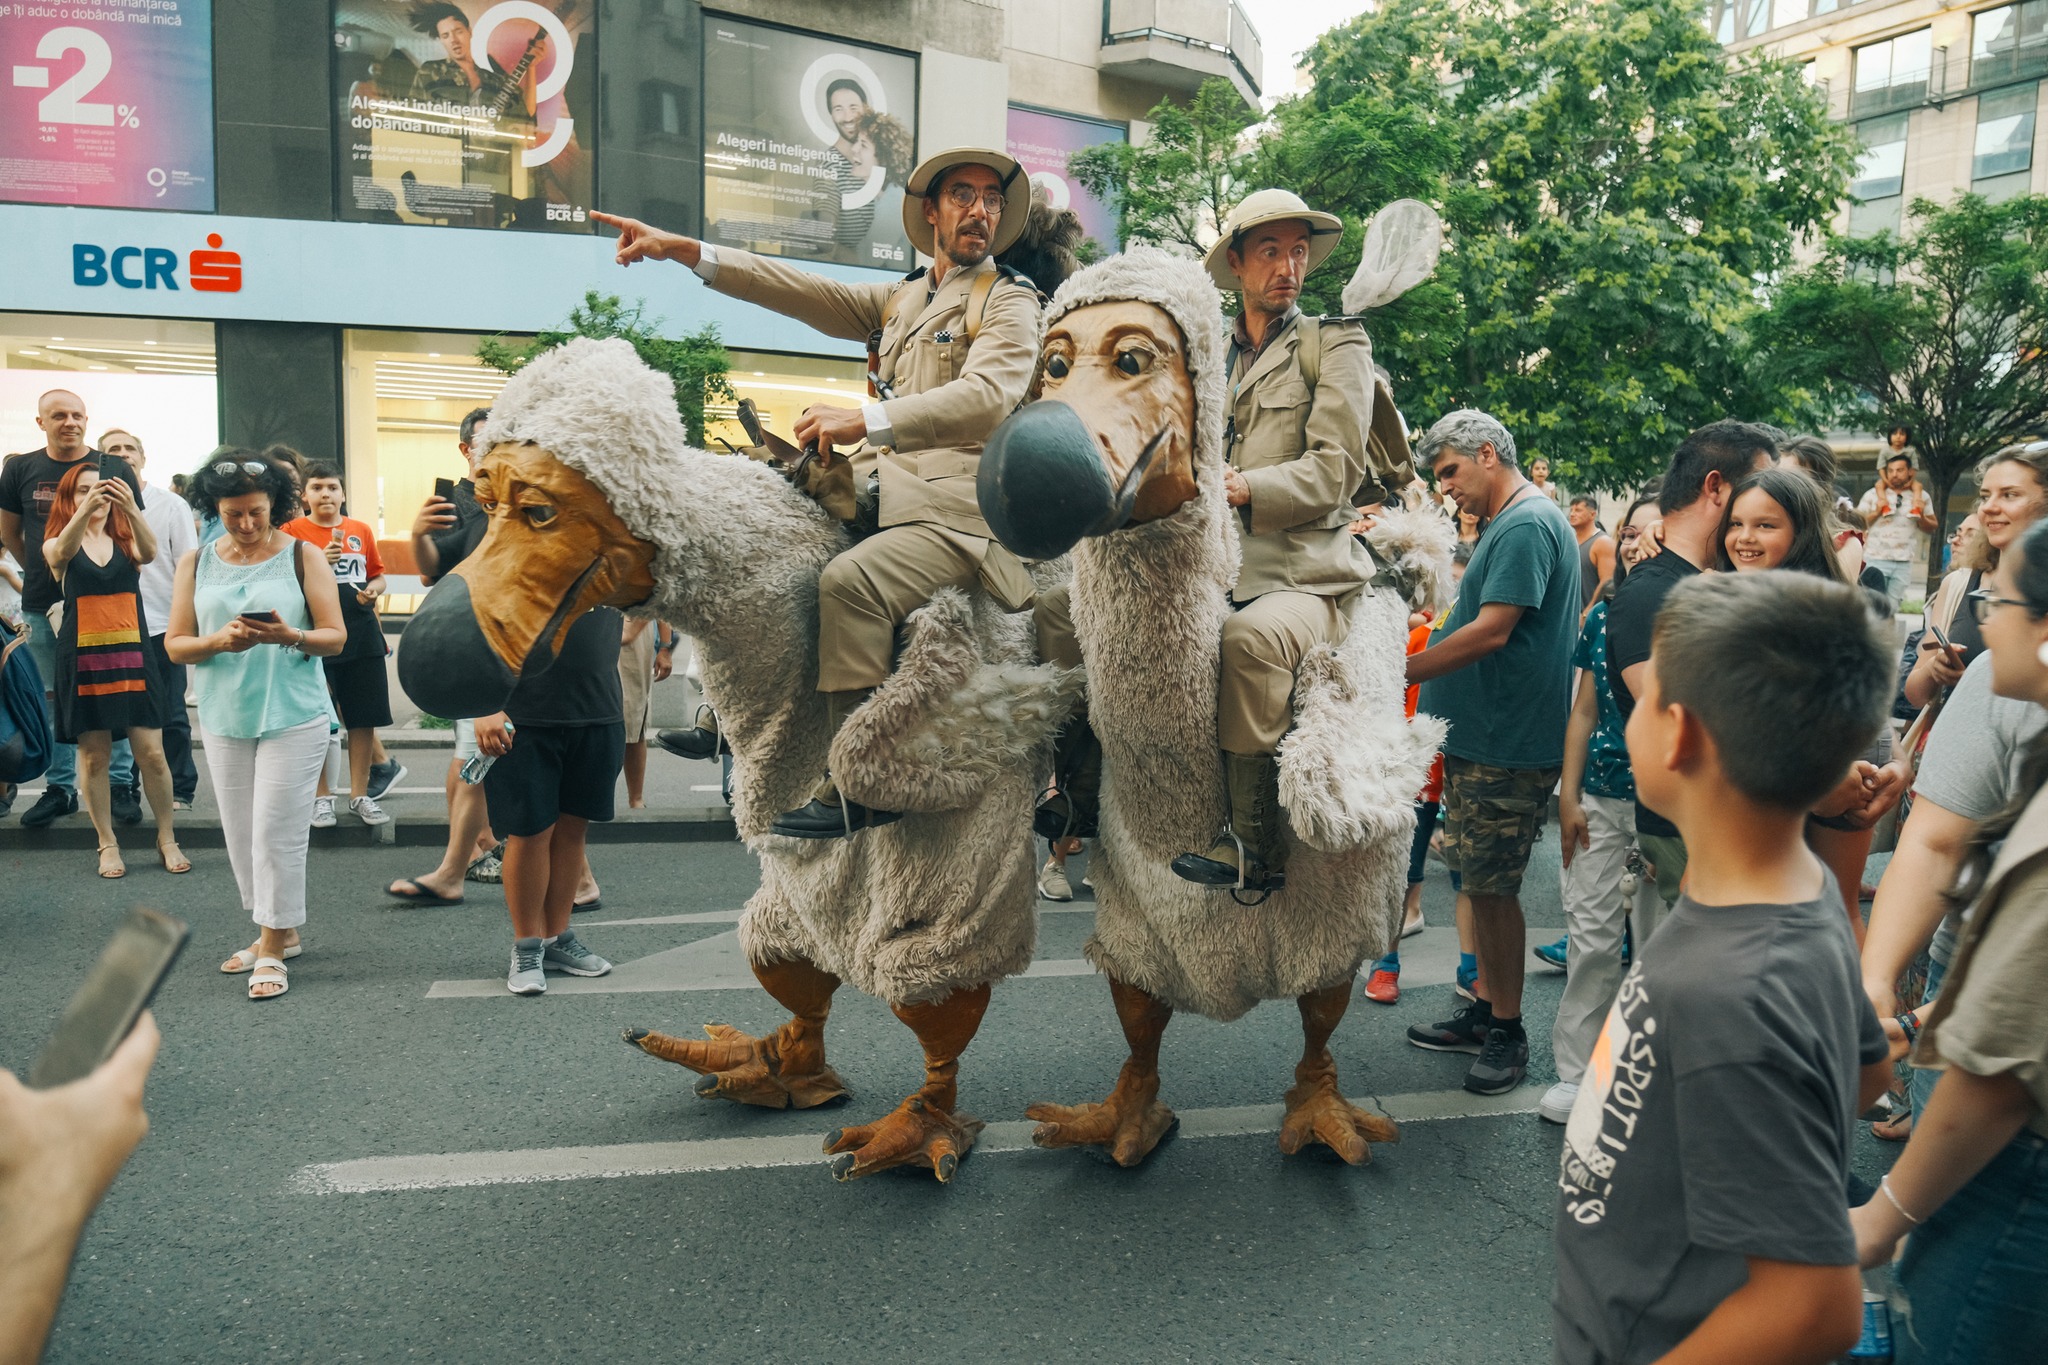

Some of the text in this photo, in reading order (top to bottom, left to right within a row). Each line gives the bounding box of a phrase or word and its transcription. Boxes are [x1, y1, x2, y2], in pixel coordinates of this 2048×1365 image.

[28, 6, 57, 18] aduc
[61, 9, 68, 18] o
[72, 8, 124, 22] dobândă
[128, 12, 150, 24] mai
[153, 14, 182, 26] mică
[352, 95, 502, 121] Alegeri inteligente,
[425, 120, 455, 135] mai
[716, 132, 843, 167] Alegeri inteligente,
[717, 150, 838, 180] dobândă mai mică
[546, 209, 571, 222] BCR
[872, 247, 893, 260] BCR
[73, 243, 180, 290] BCR
